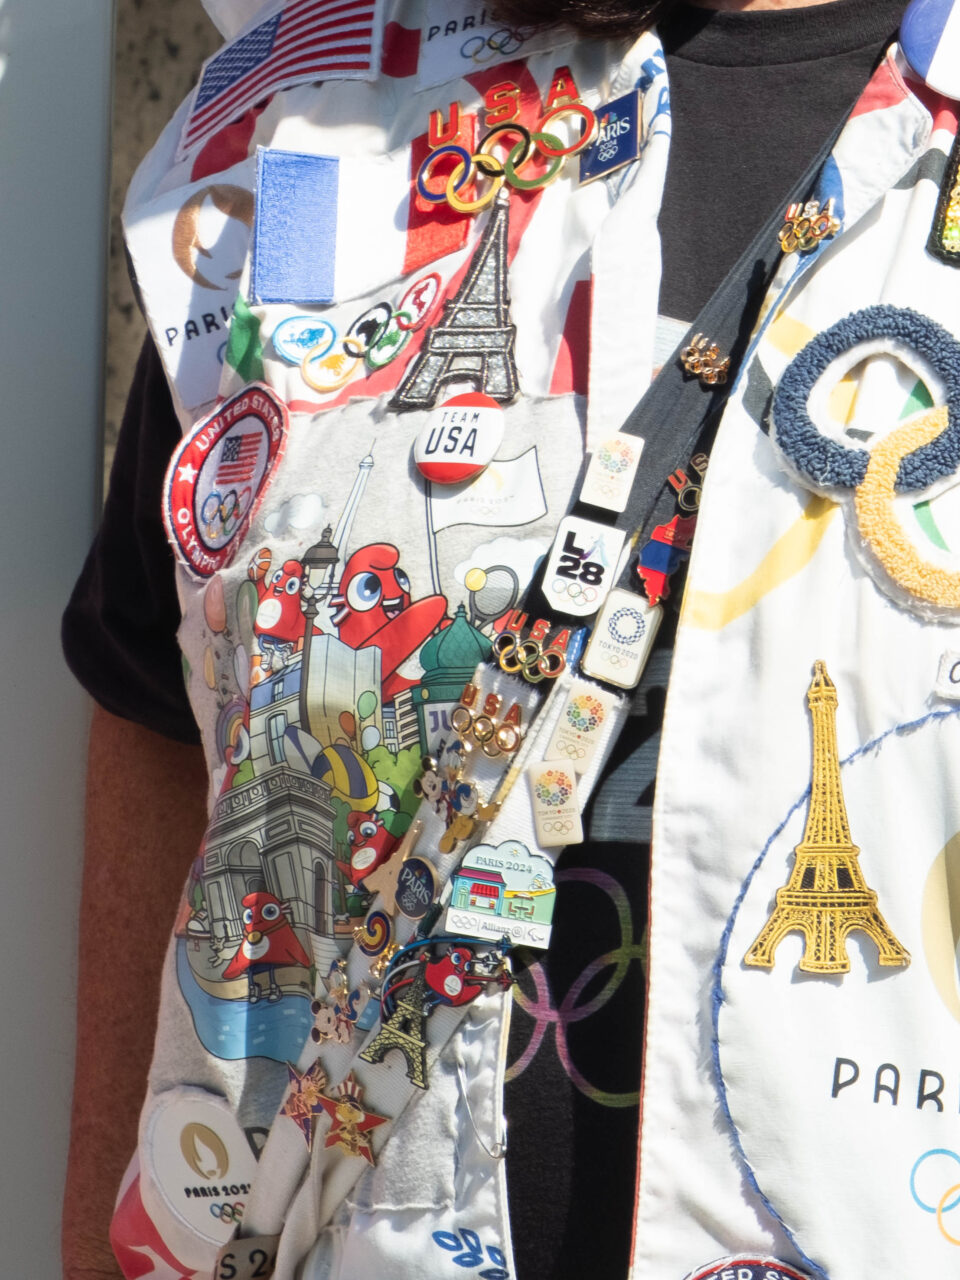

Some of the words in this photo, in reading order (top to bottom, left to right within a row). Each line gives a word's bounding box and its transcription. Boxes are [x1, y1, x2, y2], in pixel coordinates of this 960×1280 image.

[427, 8, 487, 42] PARI
[428, 64, 583, 149] USA
[597, 116, 631, 146] ARIS
[165, 306, 229, 347] PARI
[195, 397, 250, 452] UNITED
[441, 412, 480, 423] TEAM
[424, 426, 478, 457] USA
[667, 452, 709, 492] US
[555, 554, 605, 586] 28
[506, 609, 571, 652] USA
[599, 640, 621, 654] TOKYO
[475, 856, 504, 869] PARIS
[505, 860, 533, 874] 2024
[401, 867, 432, 905] PARIS
